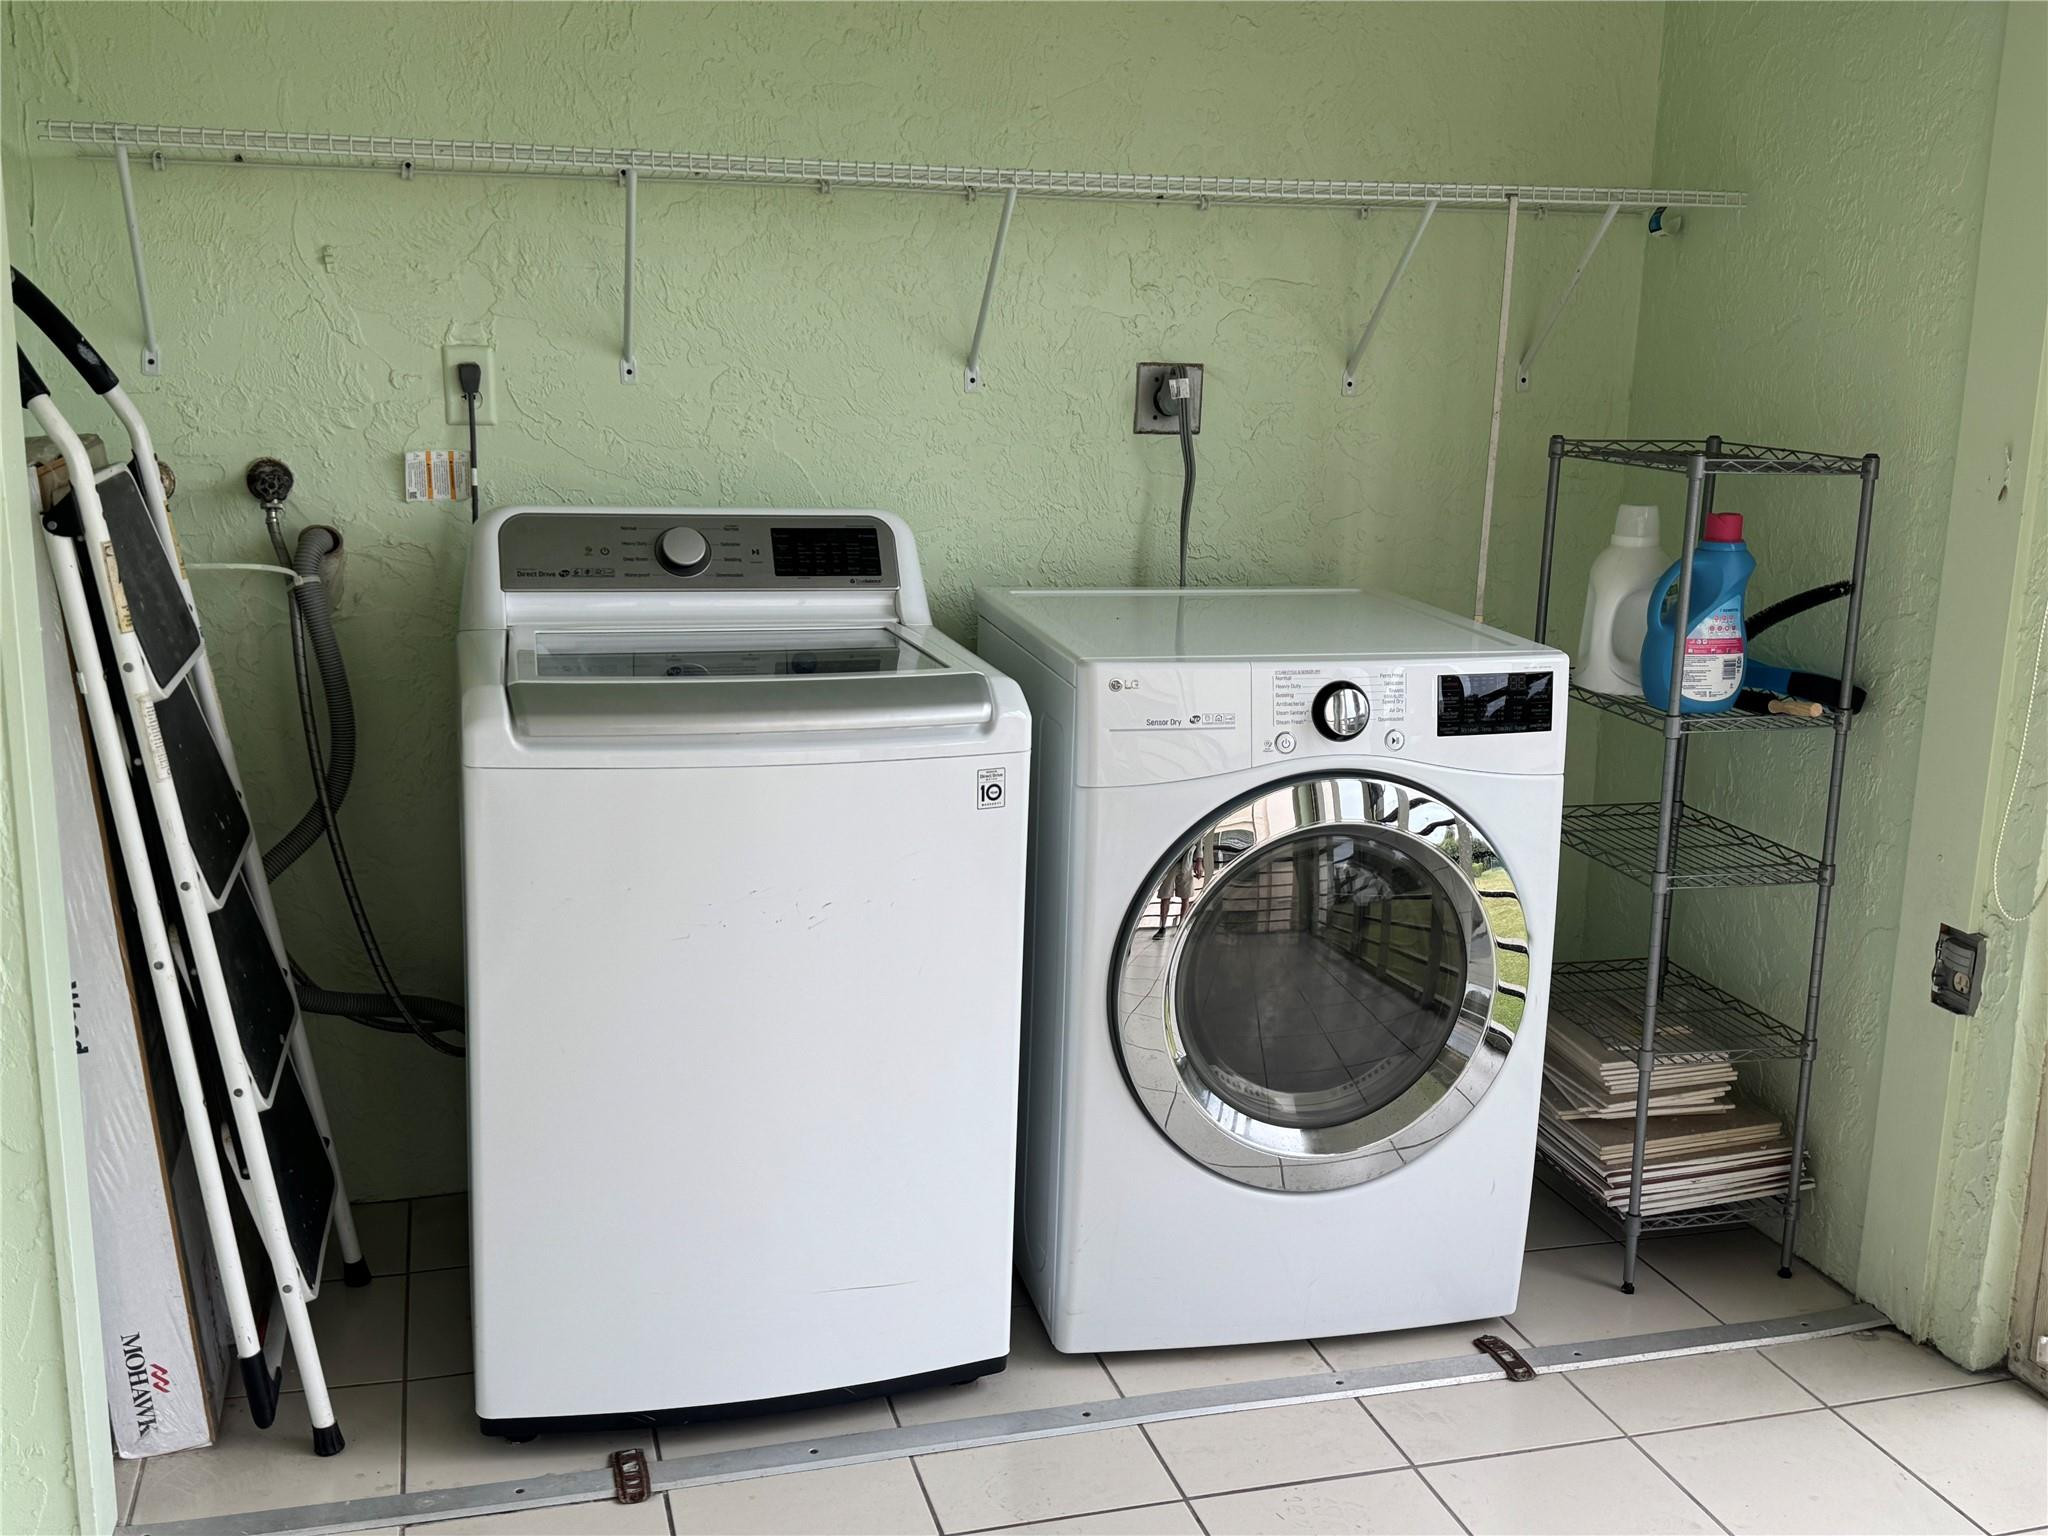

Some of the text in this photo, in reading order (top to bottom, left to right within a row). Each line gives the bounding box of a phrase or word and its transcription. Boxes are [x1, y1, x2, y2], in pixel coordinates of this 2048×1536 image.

[1124, 679, 1140, 690] LG
[1146, 718, 1182, 727] Sensor Dry
[980, 783, 1002, 802] 10
[120, 1332, 157, 1438] MOHAWK
